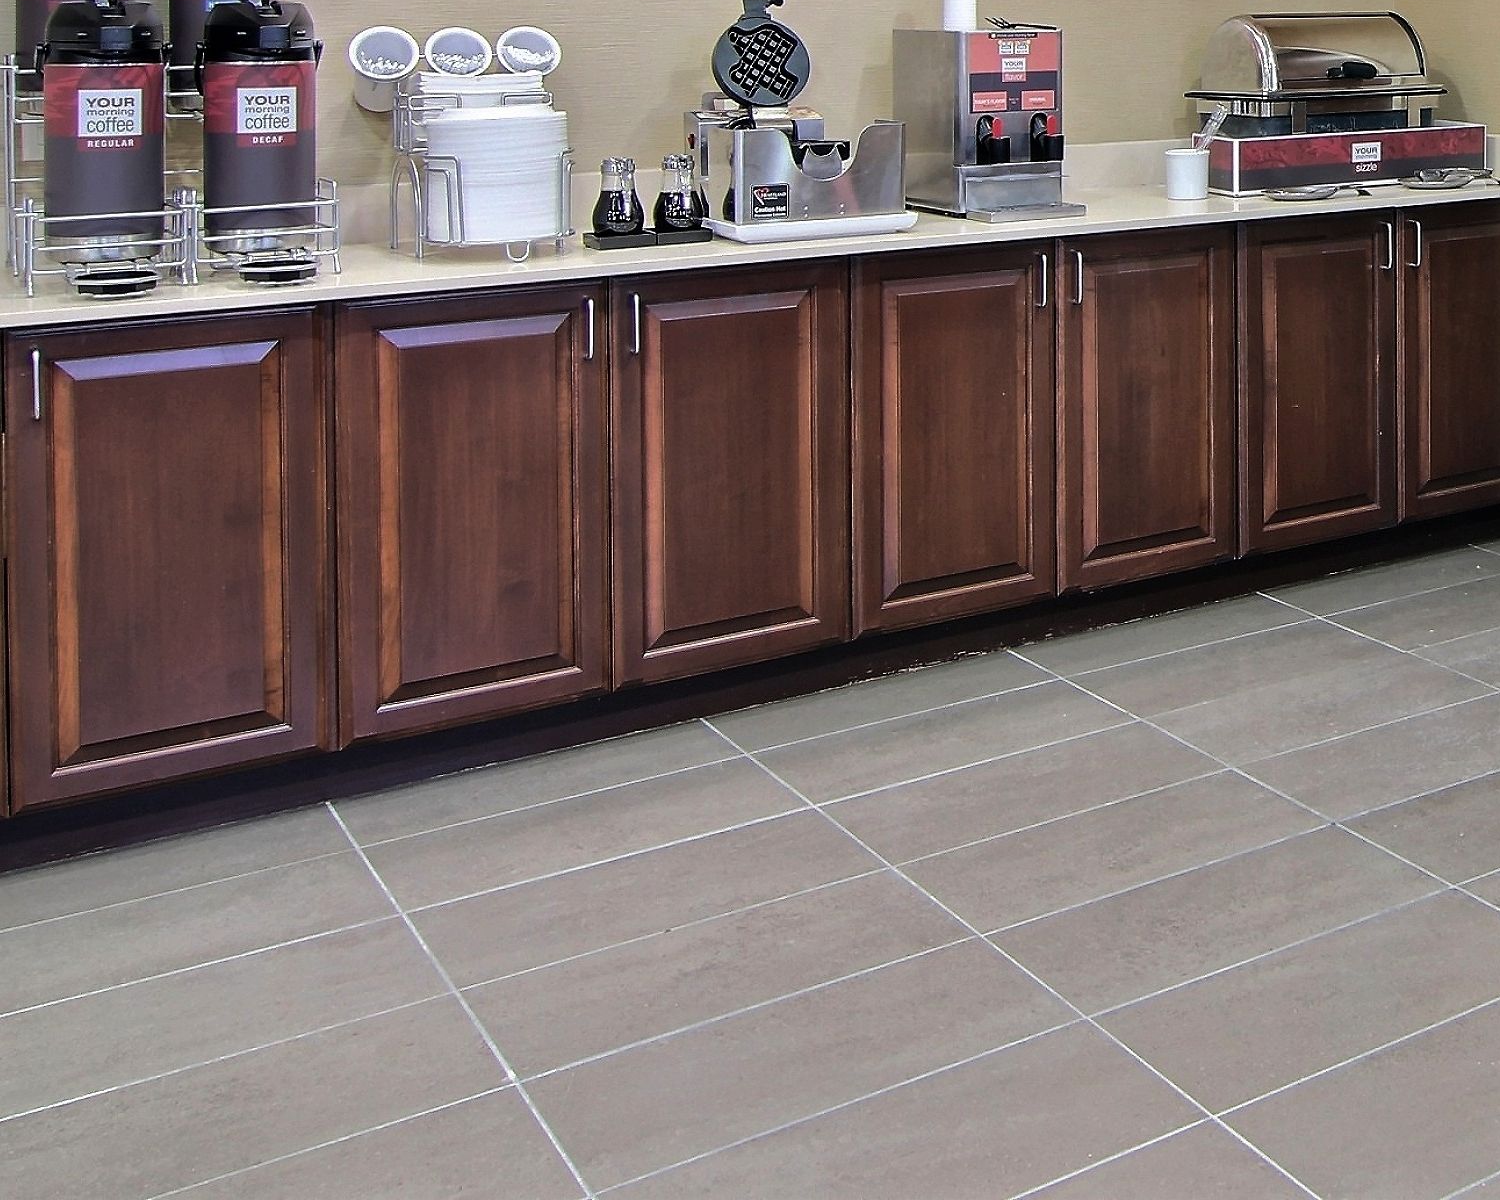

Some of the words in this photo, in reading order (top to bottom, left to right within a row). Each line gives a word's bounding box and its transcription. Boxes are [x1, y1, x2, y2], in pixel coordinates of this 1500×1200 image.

[86, 97, 135, 107] YOUR
[244, 95, 290, 105] YOUR
[86, 109, 135, 117] morning
[244, 106, 290, 114] morning
[87, 117, 134, 133] coffee
[245, 114, 290, 129] coffee
[87, 139, 135, 148] REGULAR
[252, 135, 284, 144] DECAF
[1355, 163, 1377, 171] sizzle
